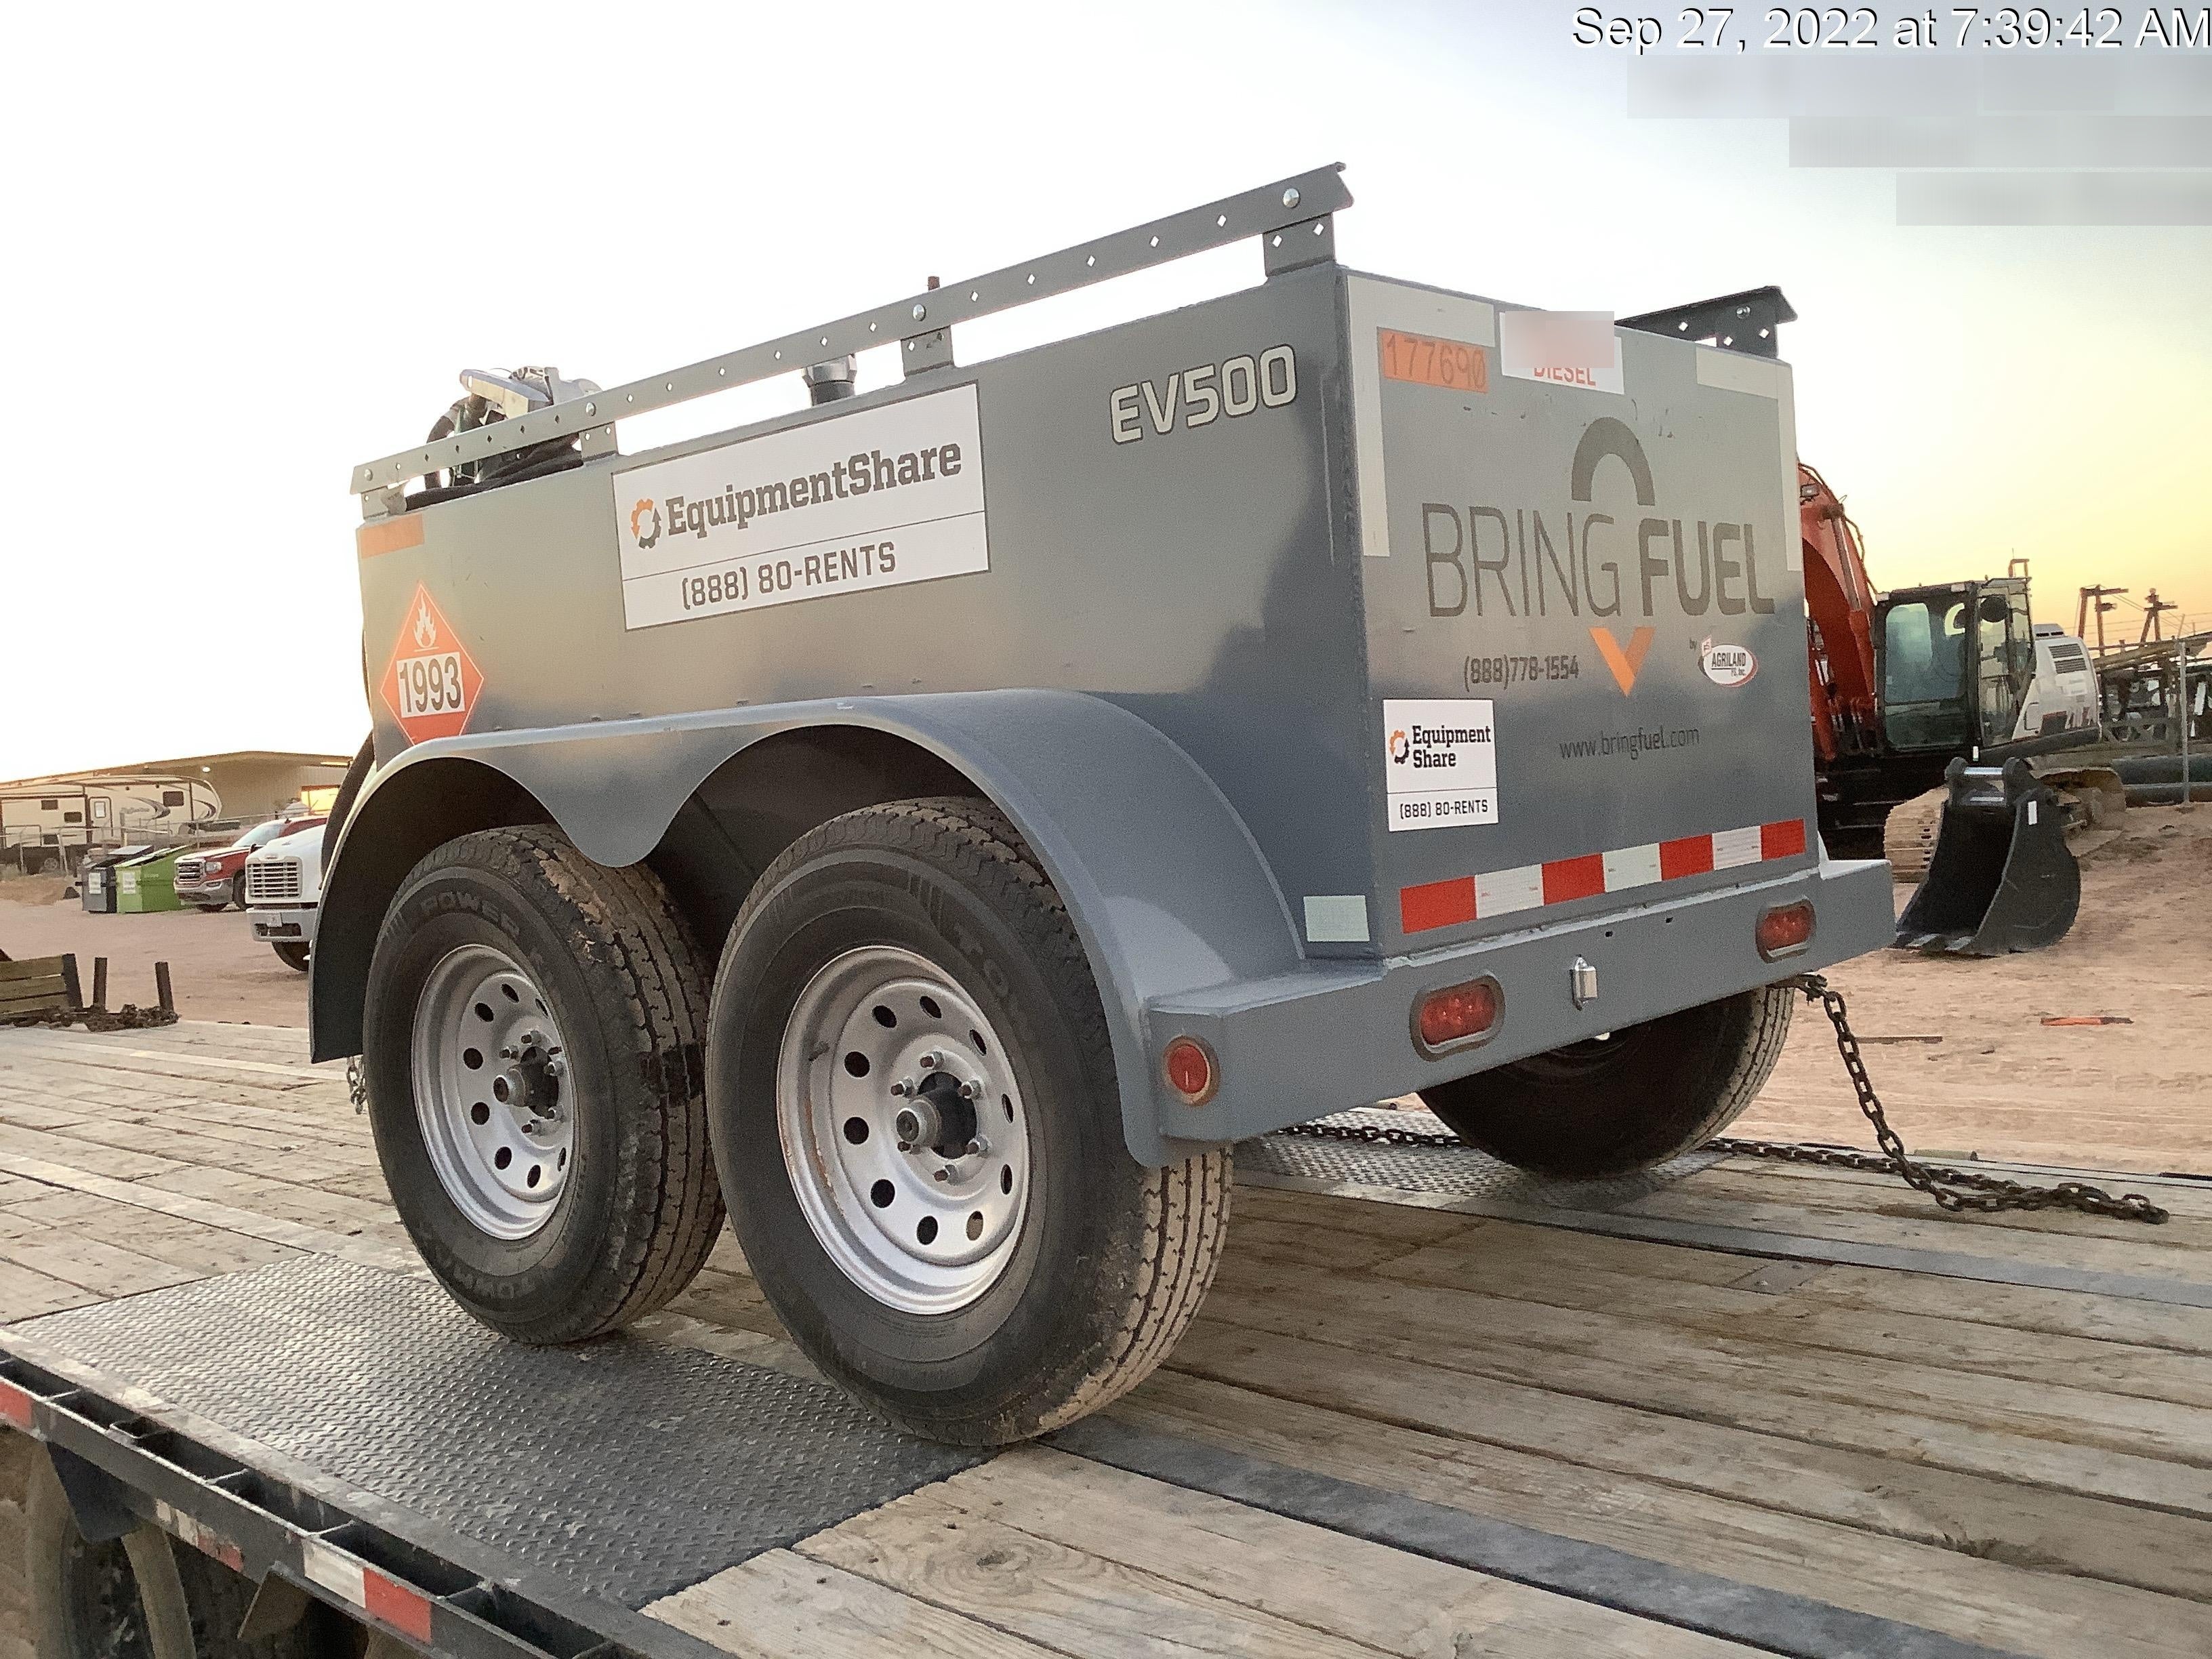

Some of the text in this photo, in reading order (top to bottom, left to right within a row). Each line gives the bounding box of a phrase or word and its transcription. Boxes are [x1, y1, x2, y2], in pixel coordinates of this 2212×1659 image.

[1387, 333, 1486, 389] 177690
[1109, 343, 1297, 445] EV500
[665, 443, 962, 539] EquipmentShare
[682, 541, 897, 610] (888) 80-RENTS
[1422, 503, 1776, 617] BRING FUEL
[400, 656, 462, 713] 1993
[1464, 655, 1580, 692] (888)778-1554
[1711, 652, 1747, 668] AGRILAND
[1412, 725, 1492, 749] Equipment
[1413, 750, 1457, 769] Share
[1559, 725, 1700, 760] www.bringfuel.com
[1399, 799, 1488, 820] (888) 80-RENTS
[419, 890, 520, 939] POWER
